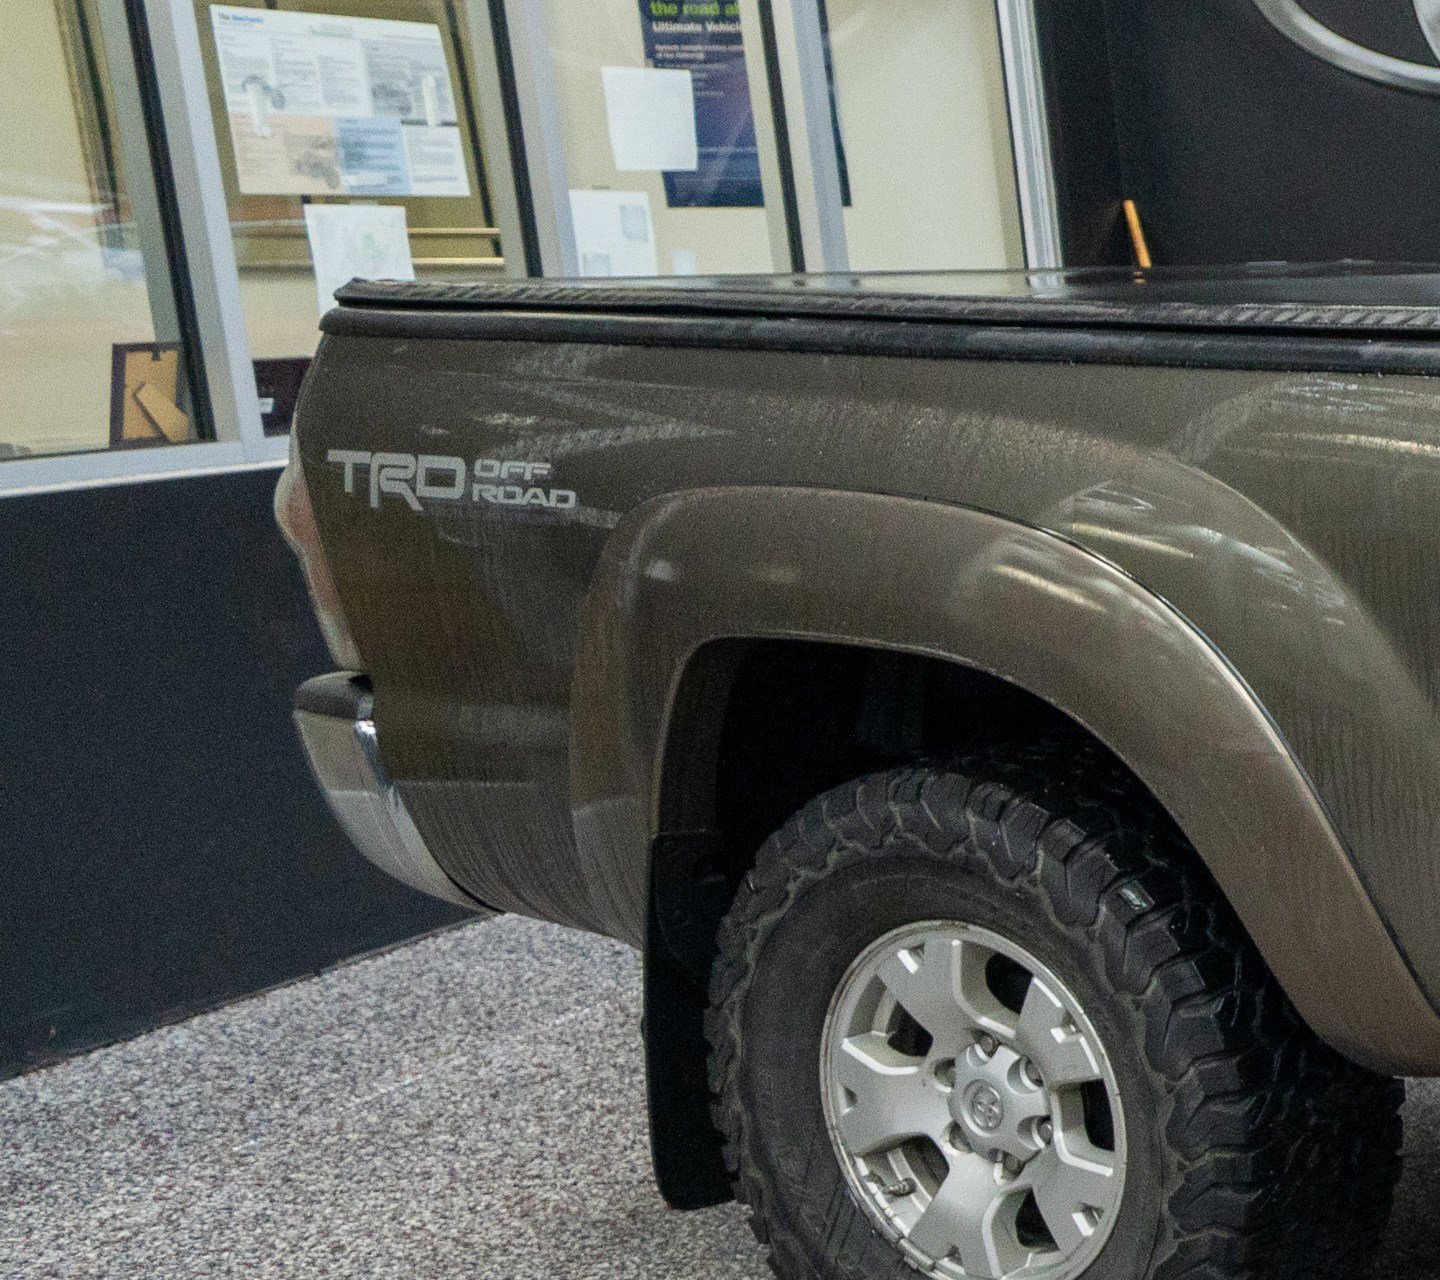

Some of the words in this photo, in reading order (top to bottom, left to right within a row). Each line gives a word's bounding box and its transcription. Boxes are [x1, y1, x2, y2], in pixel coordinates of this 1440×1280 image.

[704, 21, 741, 33] Vehicl
[326, 448, 467, 511] TRD
[474, 458, 551, 480] OFF
[472, 483, 577, 509] ROAD
